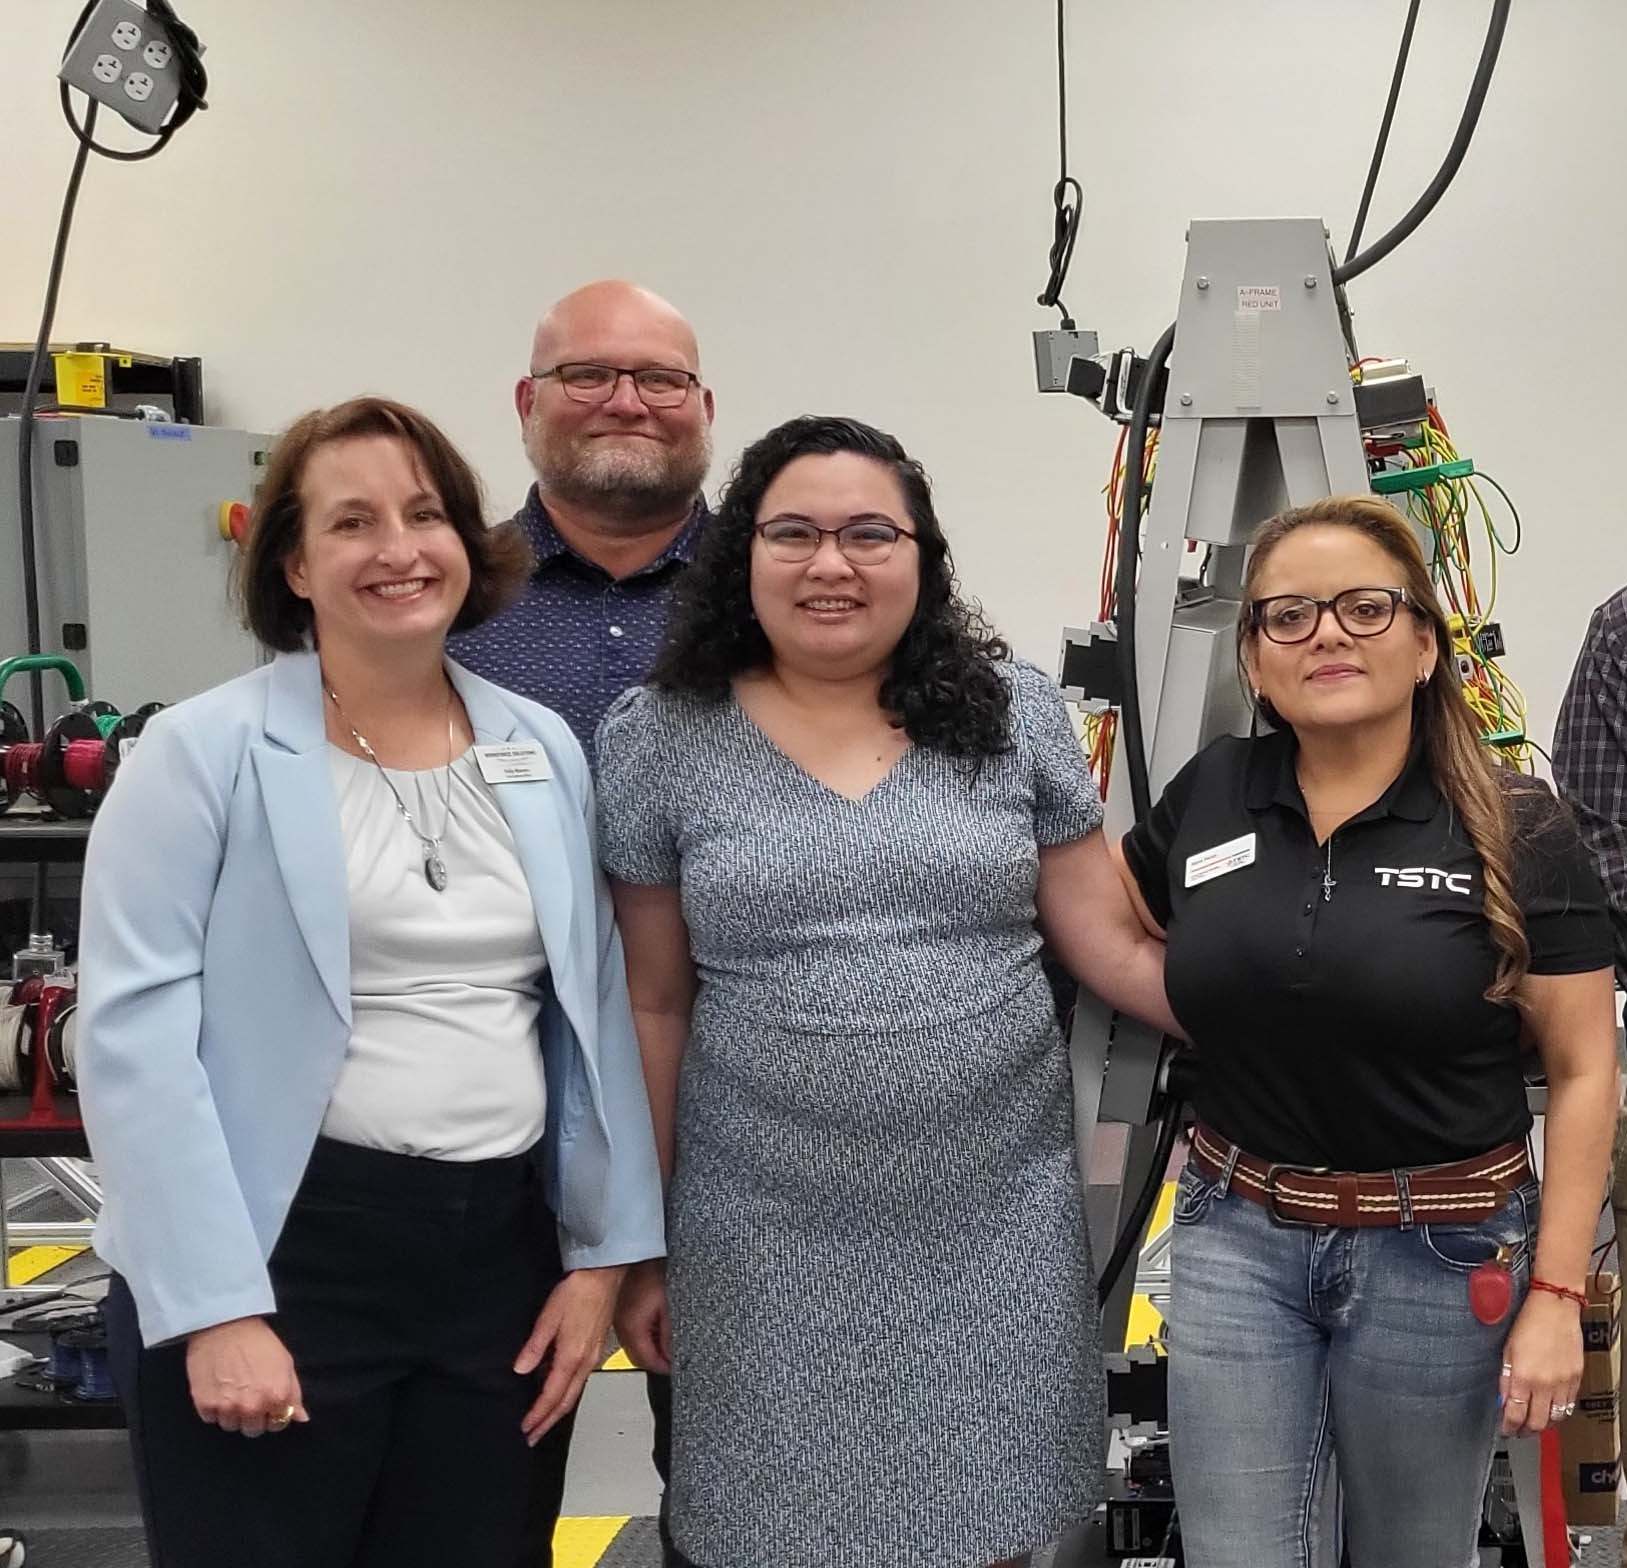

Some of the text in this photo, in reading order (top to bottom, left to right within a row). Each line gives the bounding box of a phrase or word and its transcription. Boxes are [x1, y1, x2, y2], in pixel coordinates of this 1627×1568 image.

[1241, 300, 1279, 309] RED UNIT
[1374, 867, 1472, 895] TSTC
